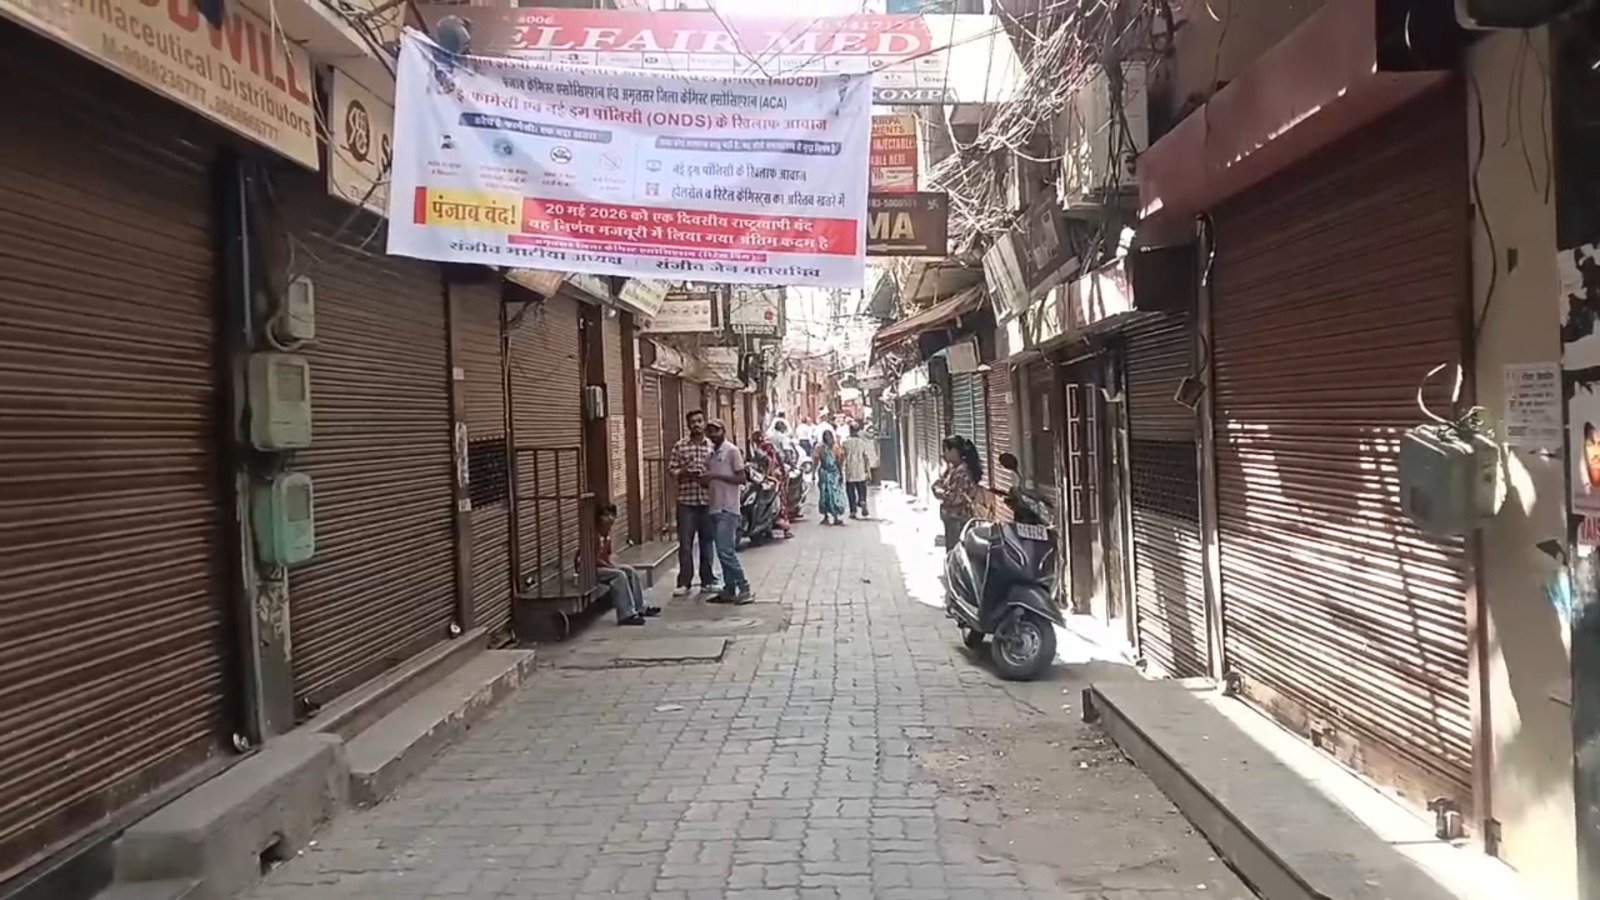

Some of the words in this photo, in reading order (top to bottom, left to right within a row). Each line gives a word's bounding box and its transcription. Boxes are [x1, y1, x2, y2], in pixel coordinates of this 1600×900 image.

[219, 61, 312, 138] Distributors
[656, 85, 678, 103] जिला
[760, 96, 787, 110] (ACA)
[647, 112, 712, 130] (ONDS)
[716, 114, 728, 129] के
[773, 193, 784, 205] का
[546, 204, 564, 215] 20
[567, 204, 586, 217] मई
[590, 207, 627, 220] 2026
[631, 209, 648, 222] को
[653, 212, 673, 223] एक
[651, 226, 663, 240] में
[667, 227, 702, 242] लिया
[705, 233, 736, 244] गया
[781, 237, 816, 248] कदम
[819, 235, 829, 250] है
